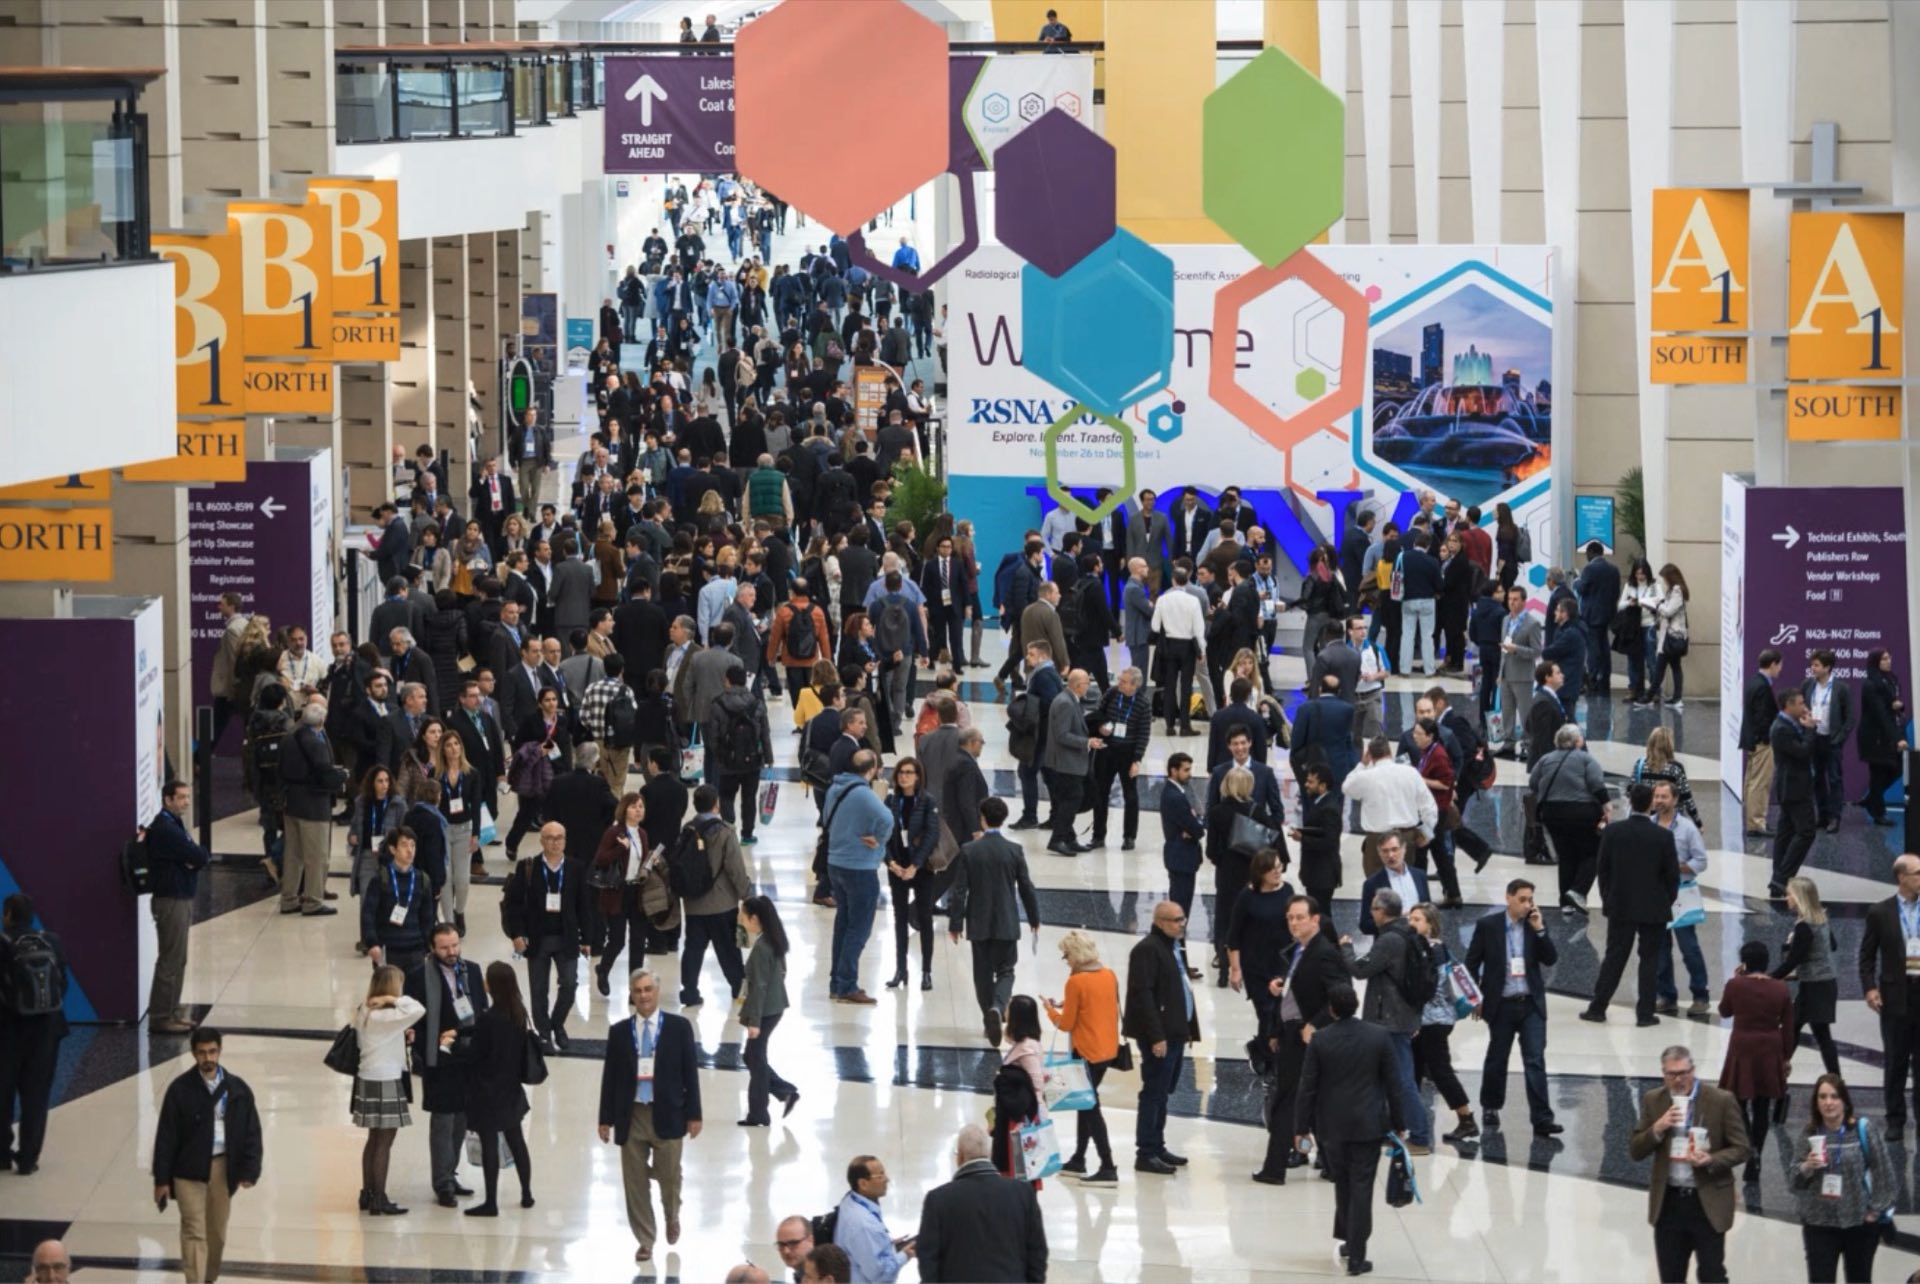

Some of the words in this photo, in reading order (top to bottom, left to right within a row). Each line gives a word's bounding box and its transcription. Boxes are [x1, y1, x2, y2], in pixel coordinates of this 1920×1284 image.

[700, 76, 735, 90] Lakesi
[699, 98, 725, 111] Coat
[621, 133, 673, 145] STRAIGHT
[628, 147, 665, 159] AHEAD
[965, 269, 1020, 283] Radiological
[1173, 270, 1216, 281] Scientific
[332, 326, 395, 344] ORTH
[1656, 345, 1742, 365] SOUTH
[1794, 395, 1896, 418] SOUTH
[992, 431, 1038, 444] Explore.
[177, 433, 238, 456] RTH
[1080, 447, 1093, 459] 26
[1094, 448, 1105, 459] to
[216, 520, 254, 531] Showcase
[0, 522, 103, 551] ORTH
[1807, 532, 1844, 543] Technical
[1846, 532, 1881, 544] Exhibits,
[216, 538, 254, 550] Showcase
[224, 556, 254, 566] Pavilion
[1806, 551, 1849, 562] Publishers
[1851, 551, 1869, 562] Row
[209, 574, 254, 586] Registration
[1806, 571, 1834, 582] Vendor
[1836, 571, 1880, 583] Workshops
[1806, 590, 1826, 601] Food
[205, 611, 222, 621] Lost
[1854, 629, 1881, 640] Rooms
